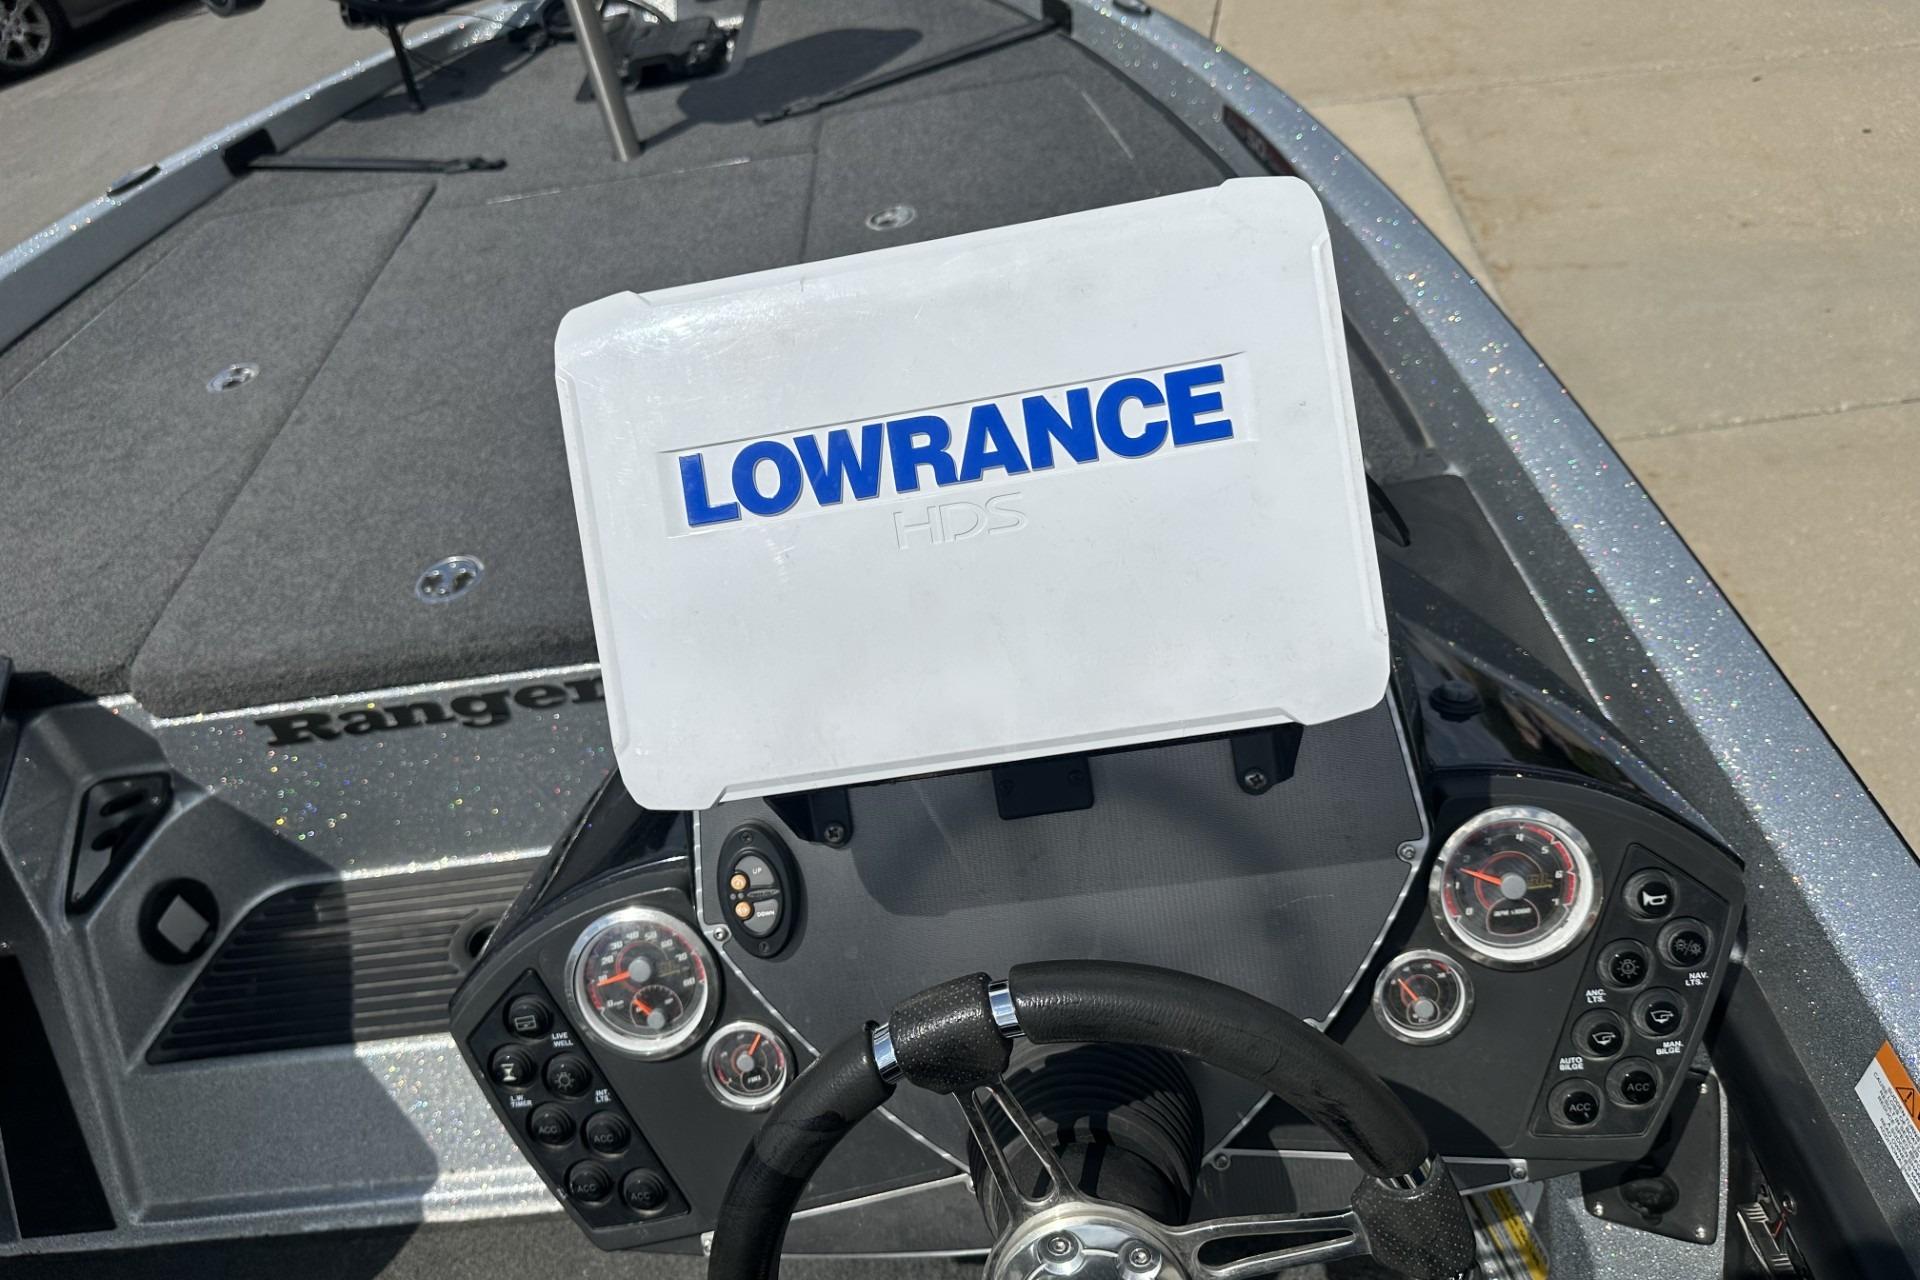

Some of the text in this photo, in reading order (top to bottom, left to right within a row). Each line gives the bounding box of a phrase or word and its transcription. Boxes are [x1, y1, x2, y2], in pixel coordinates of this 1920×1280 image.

[678, 364, 1234, 528] LOWRANCE
[892, 492, 1028, 550] HDS
[1515, 834, 1524, 842] 4
[752, 867, 762, 875] UP
[756, 909, 775, 918] DOWN
[626, 931, 639, 941] 40
[609, 941, 623, 950] 30
[601, 955, 614, 966] 20
[675, 952, 688, 961] 70
[1689, 971, 1709, 980] NAV.
[1585, 988, 1606, 996] ANC.
[1586, 995, 1606, 1003] LTS.
[551, 1032, 568, 1040] LIVE
[553, 1040, 573, 1048] WELL
[1662, 1040, 1684, 1048] MAN.
[1656, 1047, 1681, 1055] BILGE
[1560, 1056, 1583, 1064] AUTO
[1559, 1063, 1584, 1071] BILGE
[1626, 1083, 1650, 1092] ACC
[510, 1100, 532, 1108] TIMER
[1569, 1102, 1591, 1112] ACC
[538, 1125, 558, 1134] ACC
[594, 1134, 614, 1143] ACC
[577, 1184, 596, 1193] ACC
[631, 1192, 651, 1200] ACC
